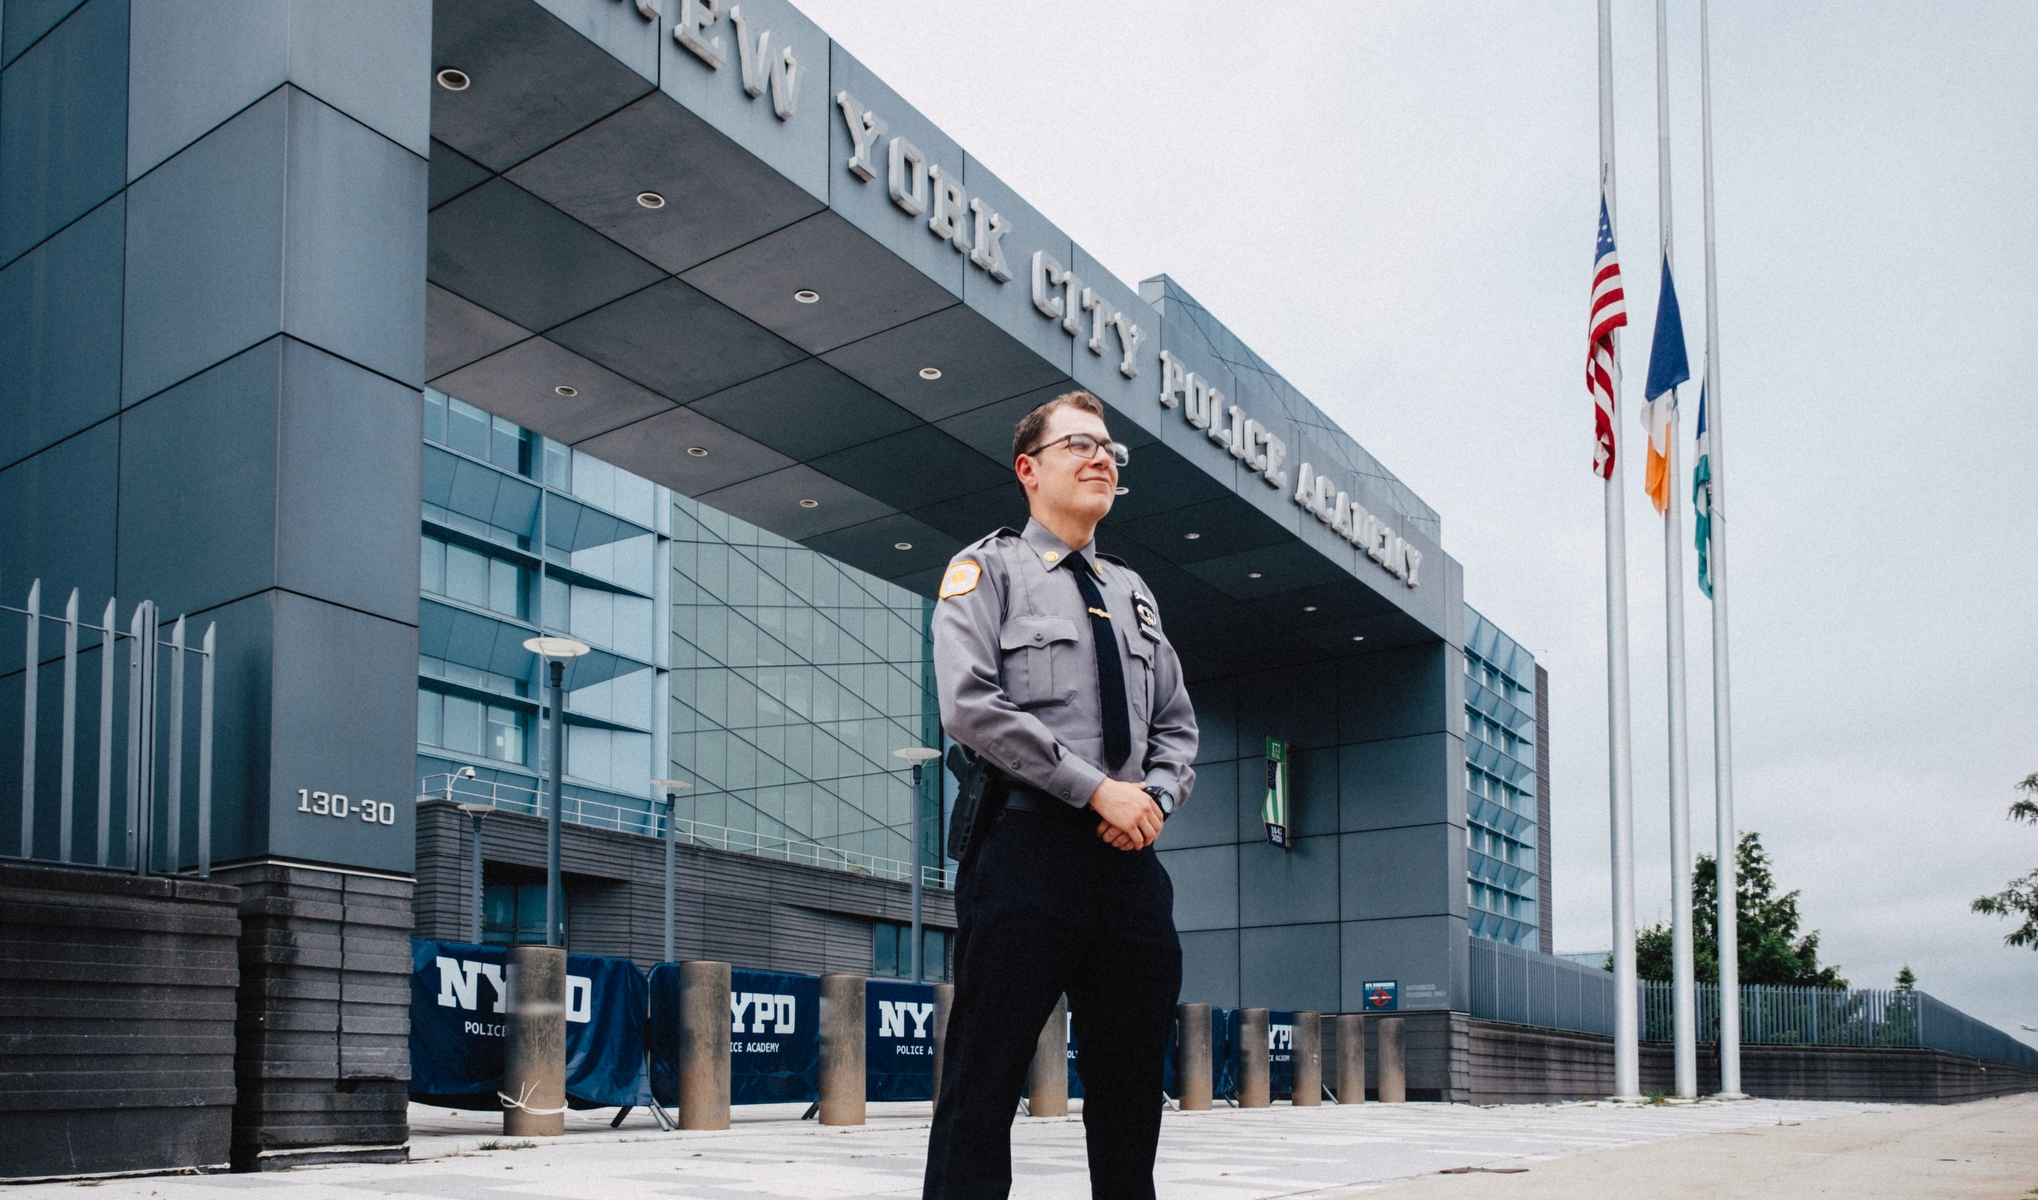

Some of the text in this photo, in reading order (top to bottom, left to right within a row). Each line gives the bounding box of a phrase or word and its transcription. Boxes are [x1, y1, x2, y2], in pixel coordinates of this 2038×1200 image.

[630, 0, 1423, 588] EW YORK CITY POLICE ACADEMY
[297, 788, 395, 826] 130-30
[436, 956, 592, 1023] NYD
[730, 991, 796, 1034] YPD
[878, 1000, 934, 1038] NY
[746, 1042, 780, 1053] ACADEMY
[896, 1045, 924, 1055] POLICE
